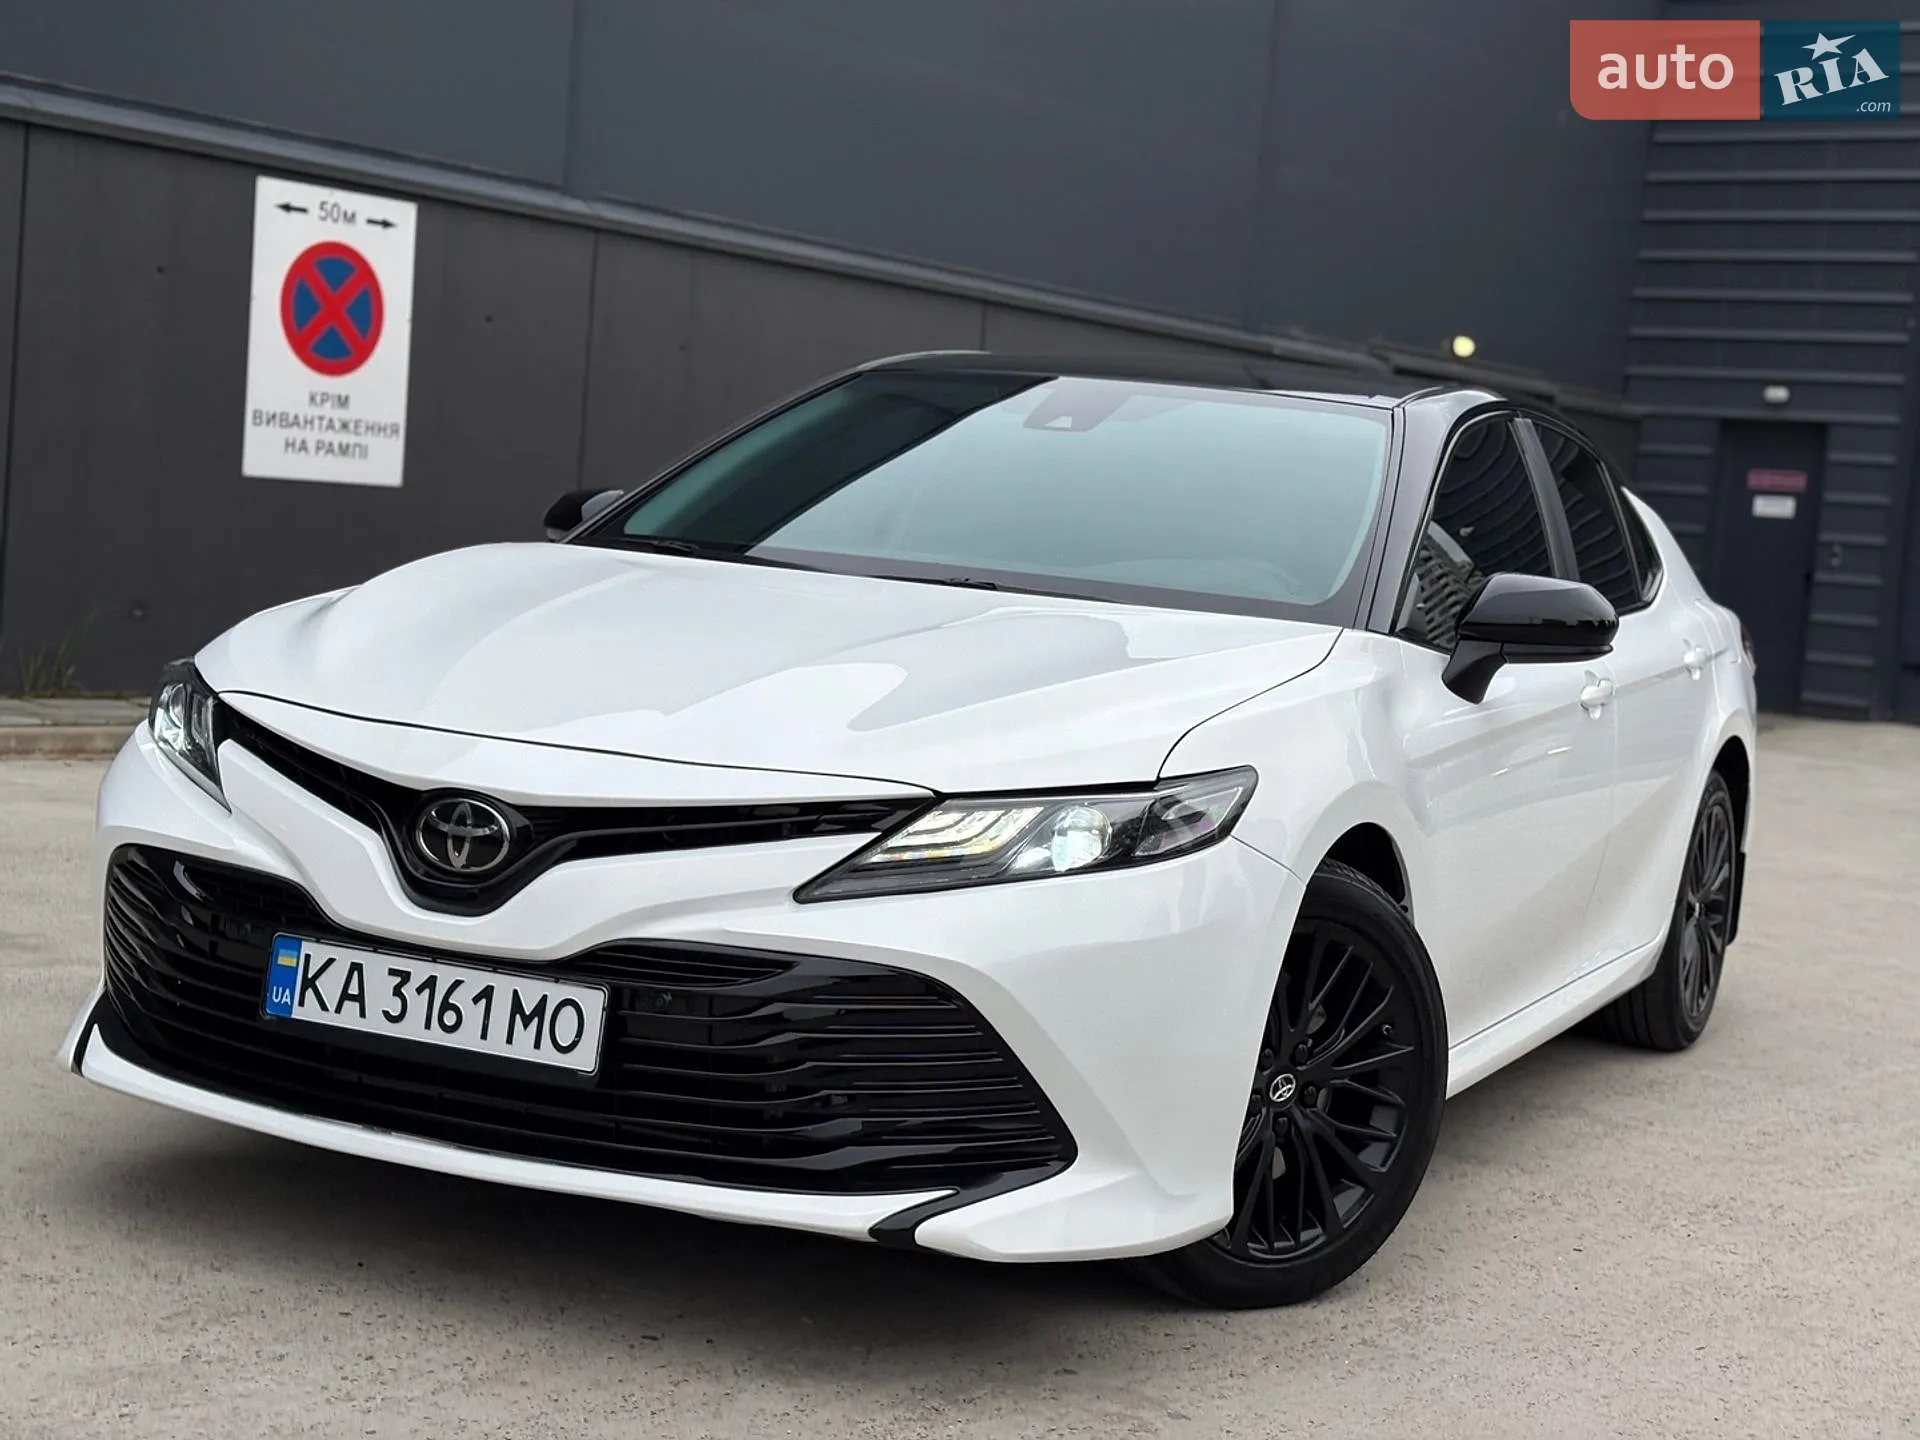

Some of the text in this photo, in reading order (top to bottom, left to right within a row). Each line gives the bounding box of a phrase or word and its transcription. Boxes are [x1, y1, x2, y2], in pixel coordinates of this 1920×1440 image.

[308, 390, 350, 410] КРІМ
[251, 408, 401, 439] ВИВАНТАЖЕННЯ
[284, 437, 369, 459] НА РАМПІ
[272, 986, 291, 1006] UA
[297, 953, 585, 1054] KA 3161 MO
